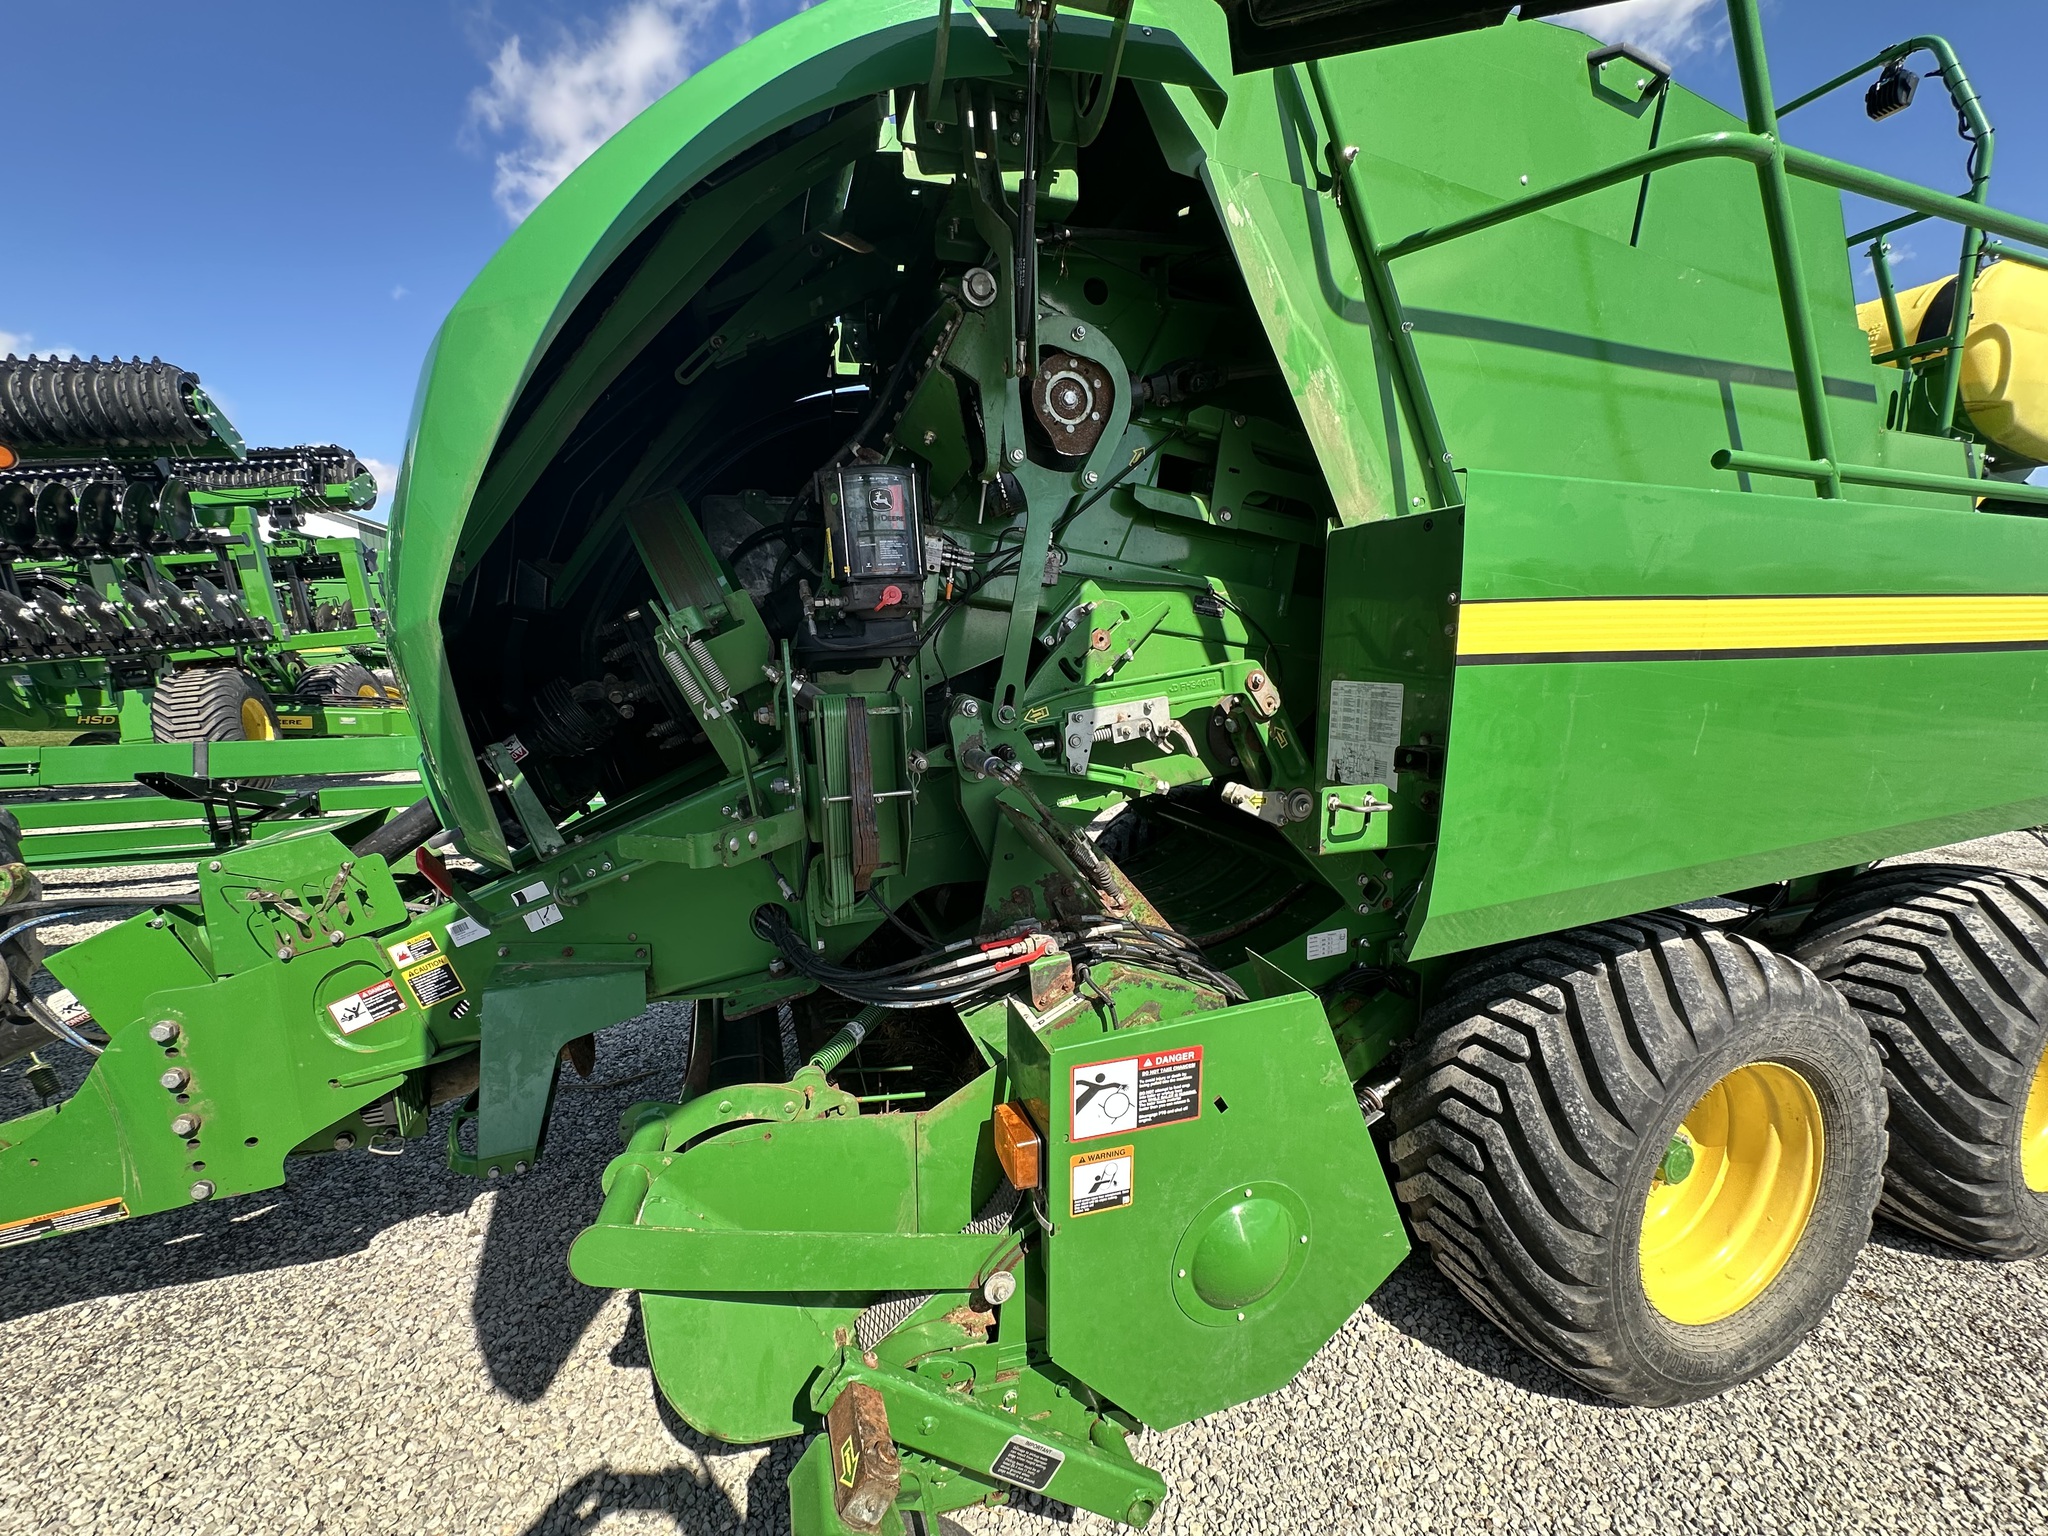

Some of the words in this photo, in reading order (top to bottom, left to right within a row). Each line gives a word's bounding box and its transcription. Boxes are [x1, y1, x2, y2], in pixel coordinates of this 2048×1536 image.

[77, 716, 115, 724] HSD
[414, 958, 444, 975] CAUTION
[368, 982, 390, 994] DANGER
[1156, 1052, 1195, 1065] DANGER
[1088, 1149, 1125, 1161] WARNING
[1025, 1441, 1052, 1454] IMPORTANT
